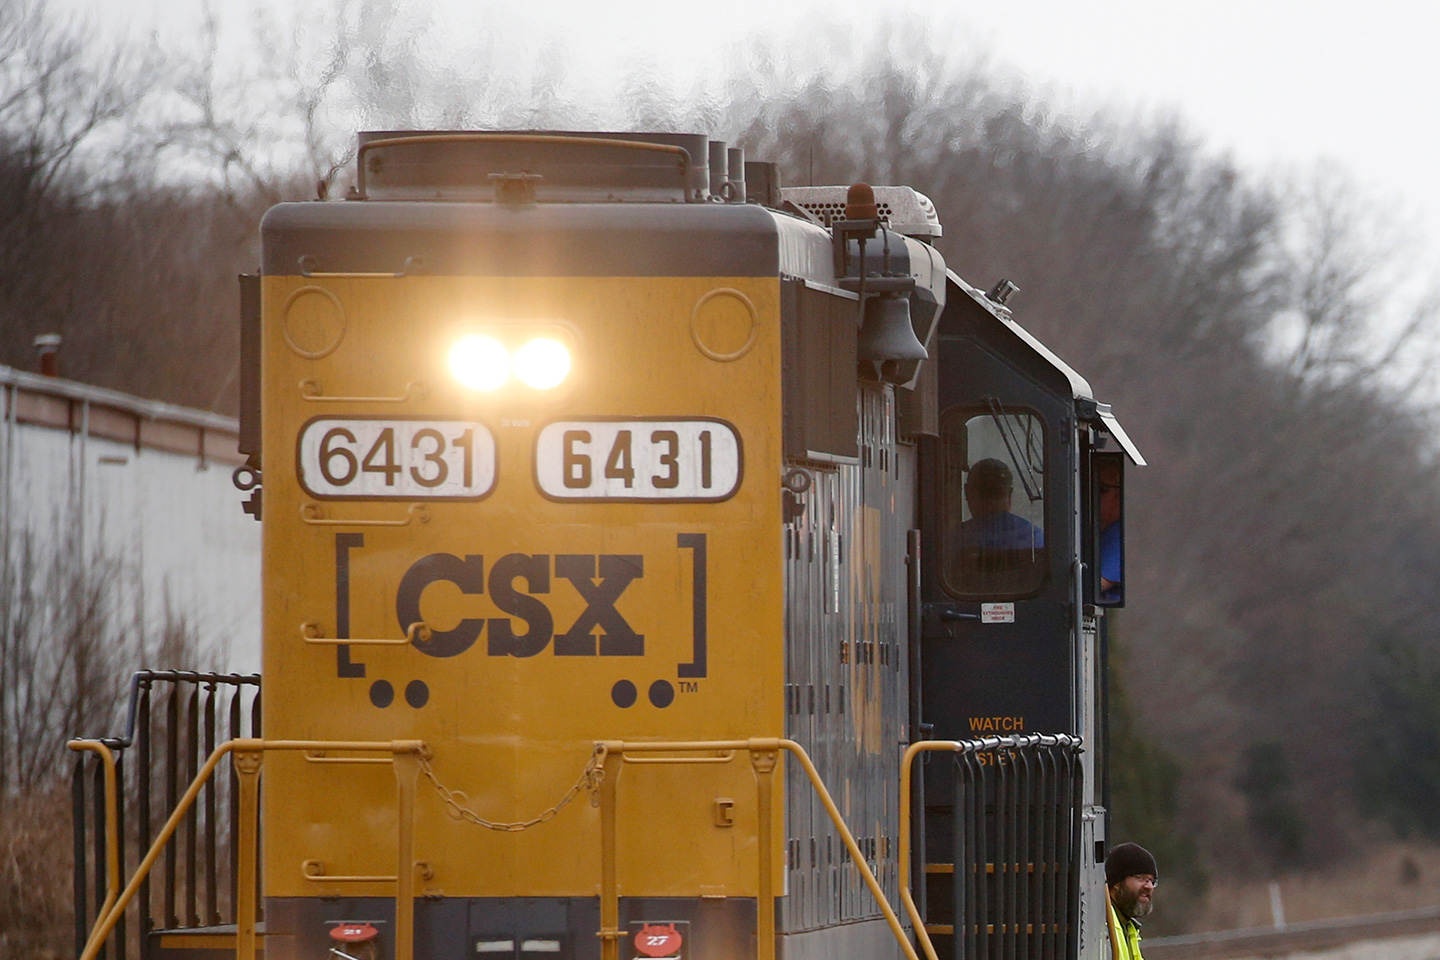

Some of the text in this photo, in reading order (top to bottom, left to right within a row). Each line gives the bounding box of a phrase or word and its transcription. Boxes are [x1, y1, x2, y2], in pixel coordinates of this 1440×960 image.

[318, 426, 474, 489] 6431
[562, 429, 713, 490] 6431
[396, 552, 645, 658] CSX
[678, 681, 698, 693] TM
[968, 716, 1024, 731] WATCH
[646, 935, 669, 946] 27
